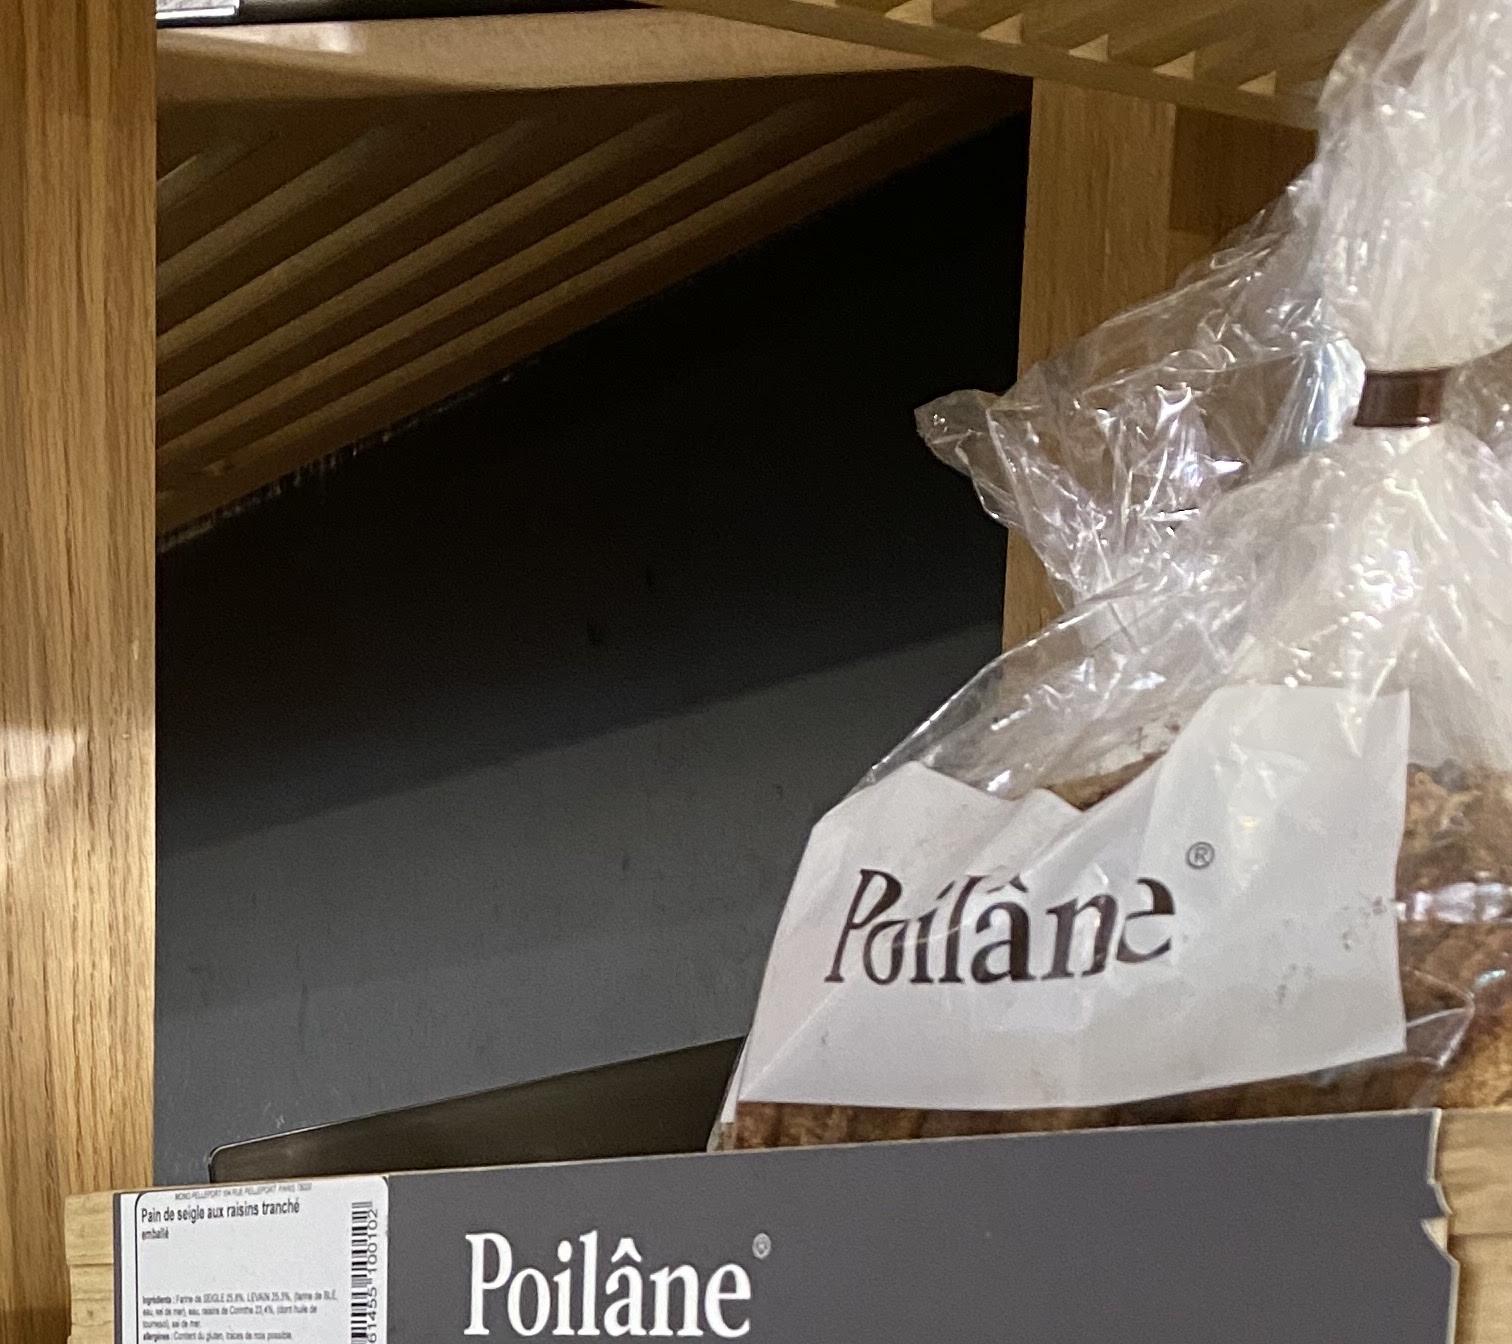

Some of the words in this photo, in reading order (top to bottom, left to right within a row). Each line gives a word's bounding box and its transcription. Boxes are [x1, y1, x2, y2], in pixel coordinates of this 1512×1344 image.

[142, 1207, 162, 1223] Pain
[163, 1205, 175, 1221] de
[177, 1205, 205, 1224] seigle
[207, 1207, 224, 1219] aux
[226, 1202, 259, 1217] raisins
[262, 1198, 300, 1216] tranché
